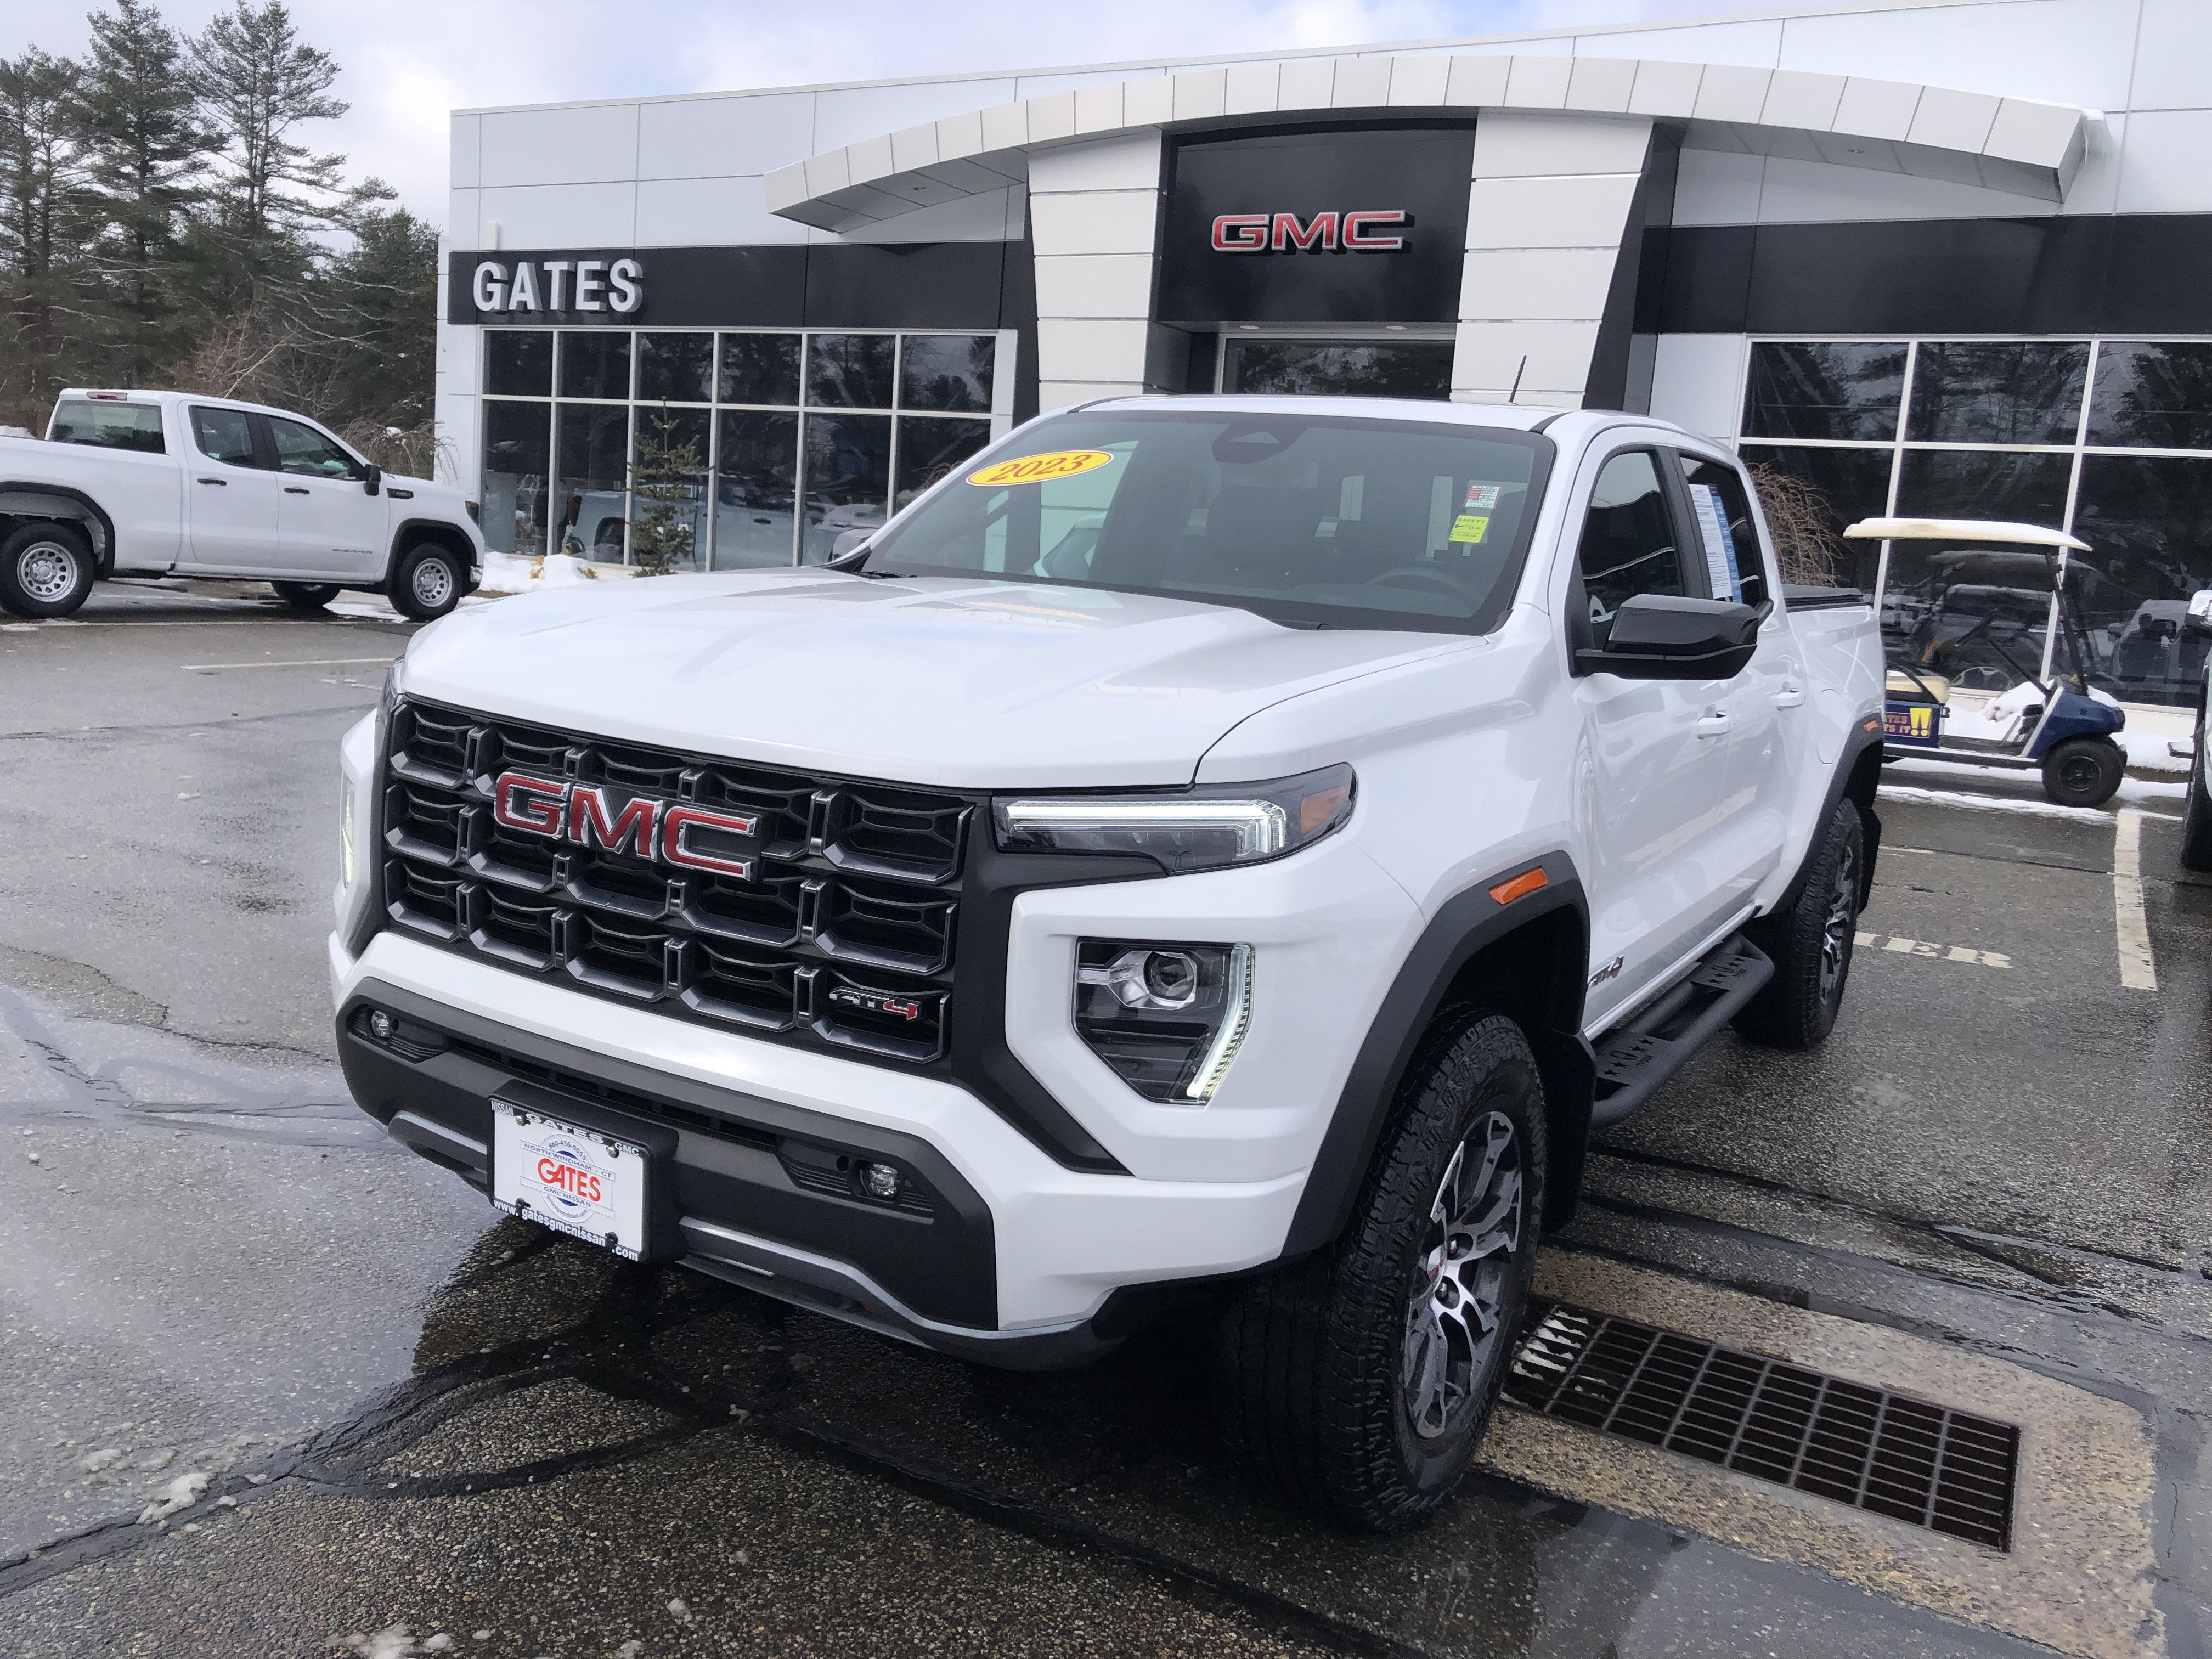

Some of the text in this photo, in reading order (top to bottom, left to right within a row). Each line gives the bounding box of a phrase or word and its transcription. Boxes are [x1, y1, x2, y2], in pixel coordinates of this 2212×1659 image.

[1211, 210, 1406, 251] GMC
[473, 258, 643, 312] GATES
[986, 454, 1092, 482] 2023
[494, 771, 757, 881] GMC
[830, 989, 921, 1020] AT4
[491, 1101, 514, 1117] NISSAN
[526, 1113, 604, 1143] GATES
[524, 1143, 551, 1156] NORTH
[552, 1153, 592, 1171] WINDHAM
[614, 1142, 639, 1156] GMC
[538, 1158, 600, 1202] GATES
[544, 1186, 591, 1207] GMC NISSAN
